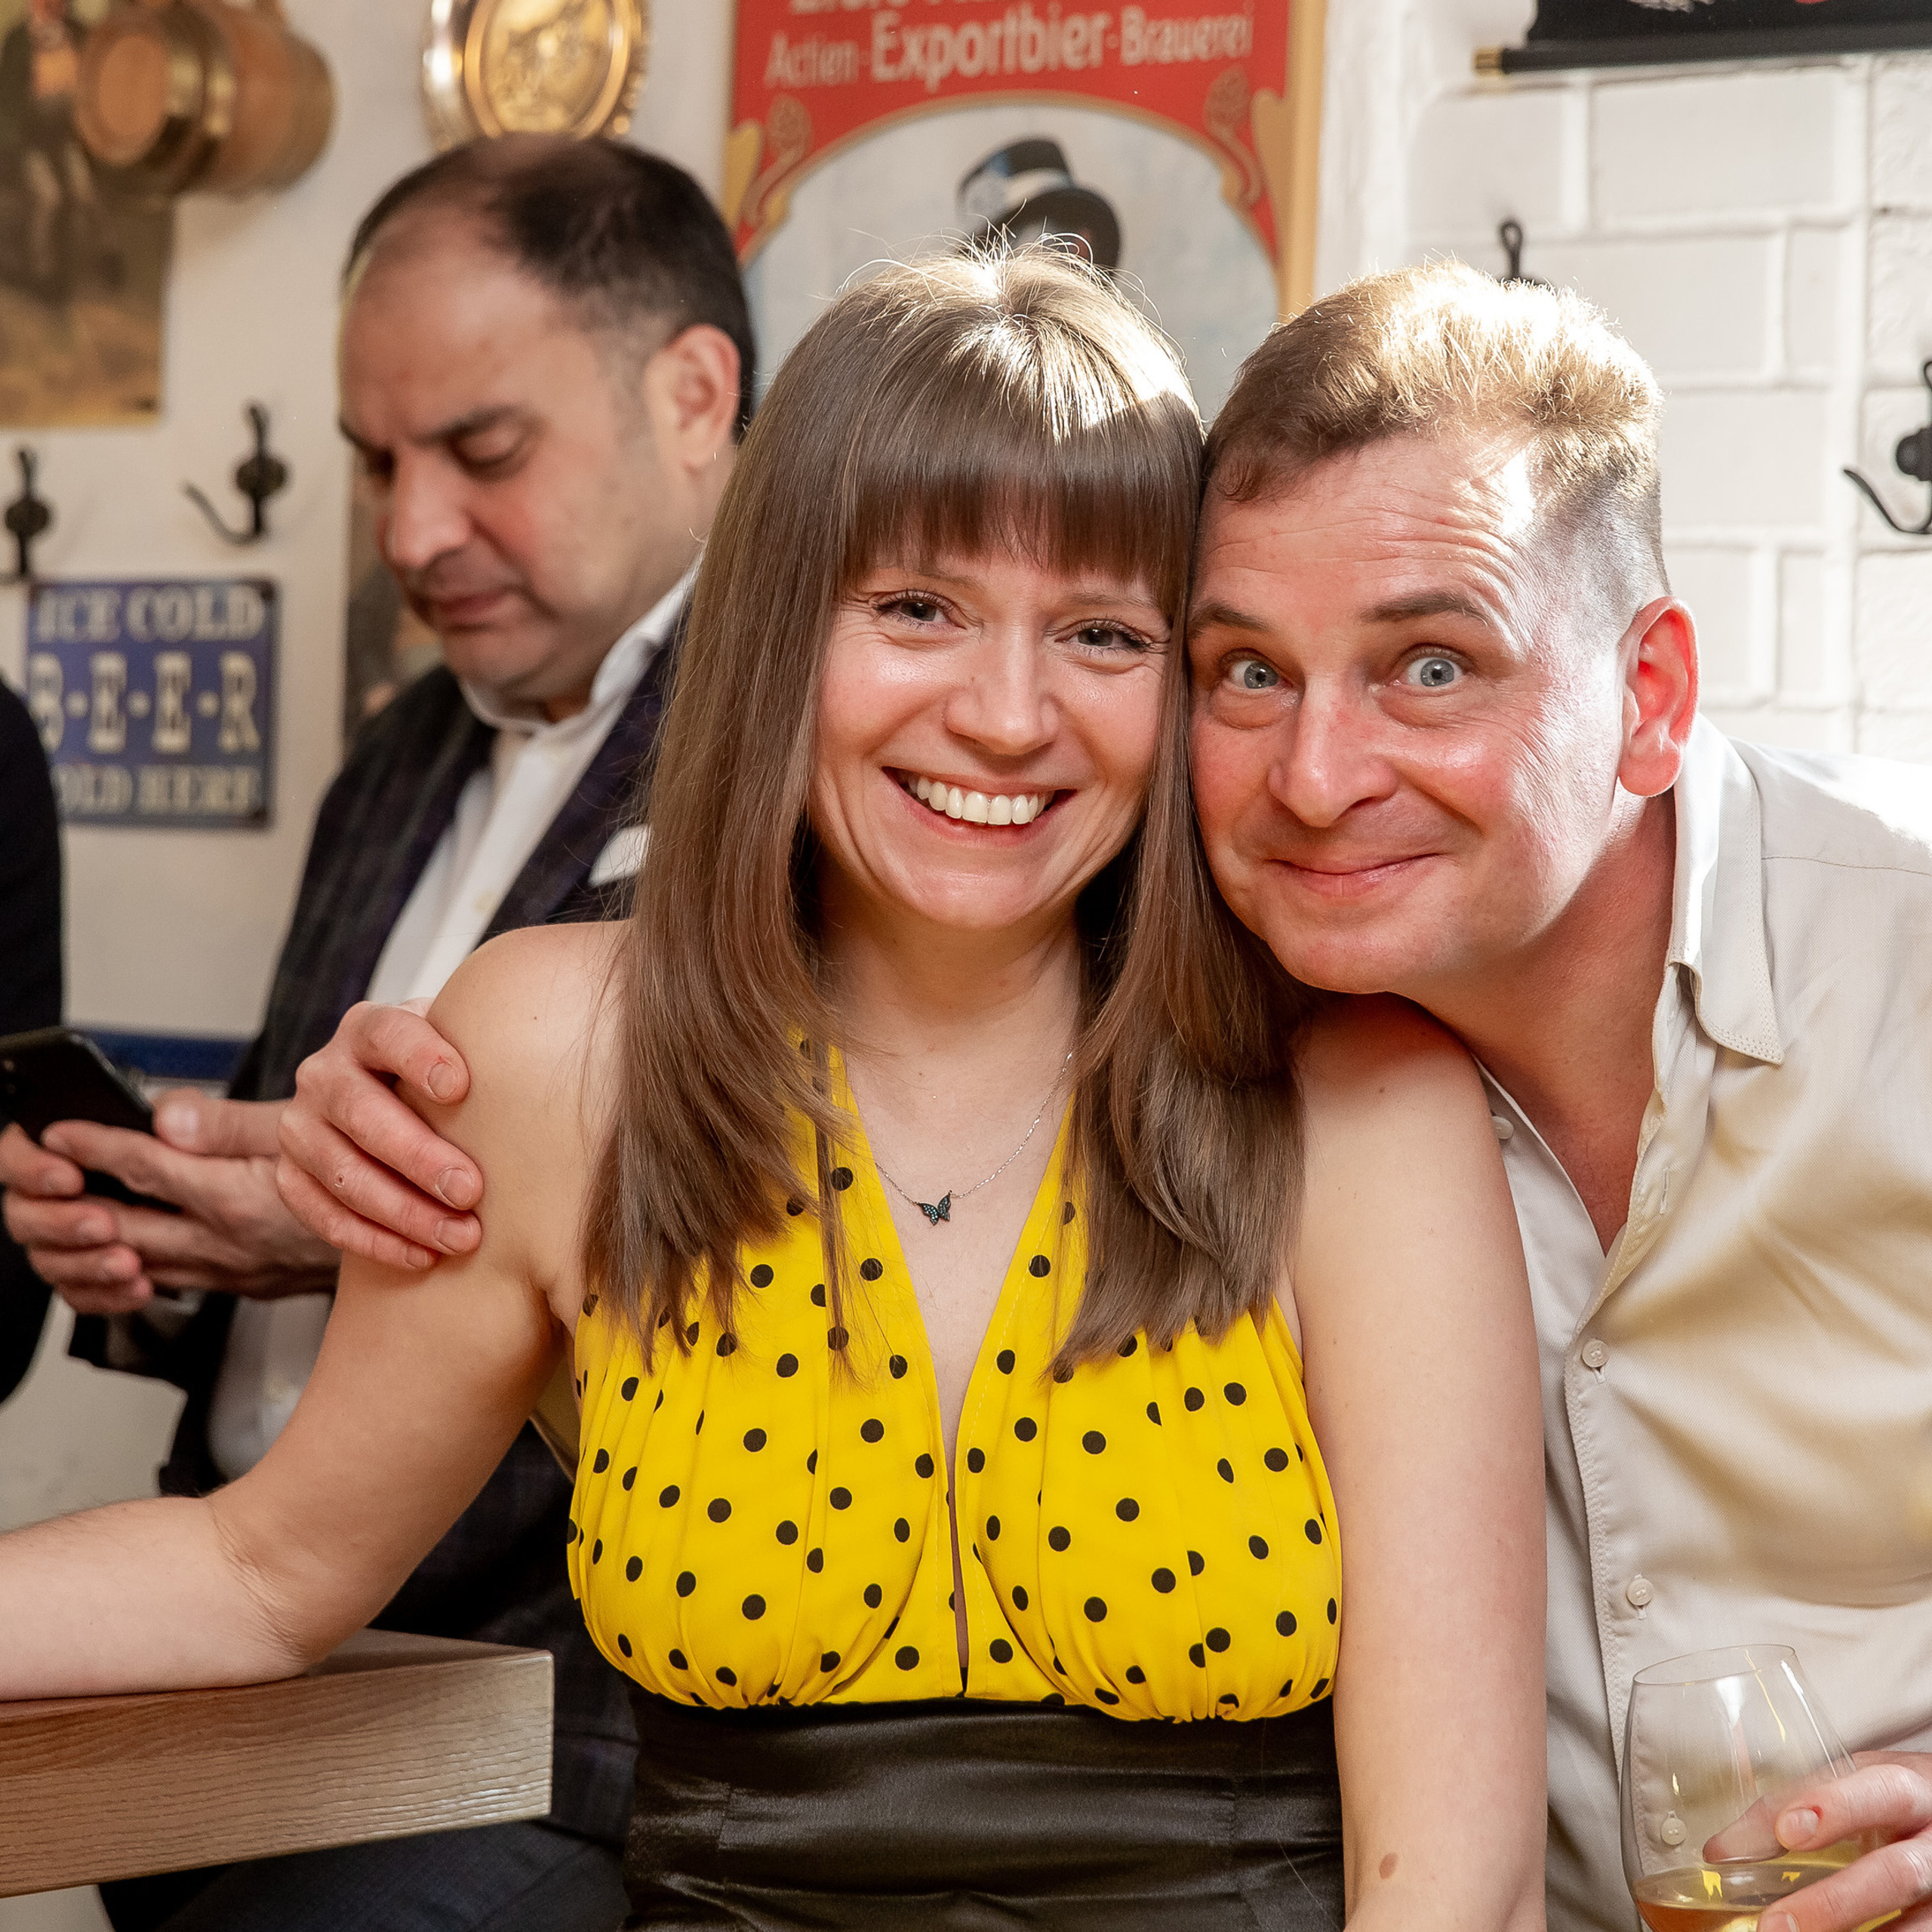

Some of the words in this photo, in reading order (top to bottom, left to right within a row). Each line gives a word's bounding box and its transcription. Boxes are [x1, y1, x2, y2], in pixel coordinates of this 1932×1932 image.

[35, 586, 122, 643] ICE
[126, 586, 266, 643] COLD
[51, 764, 134, 815] OLD
